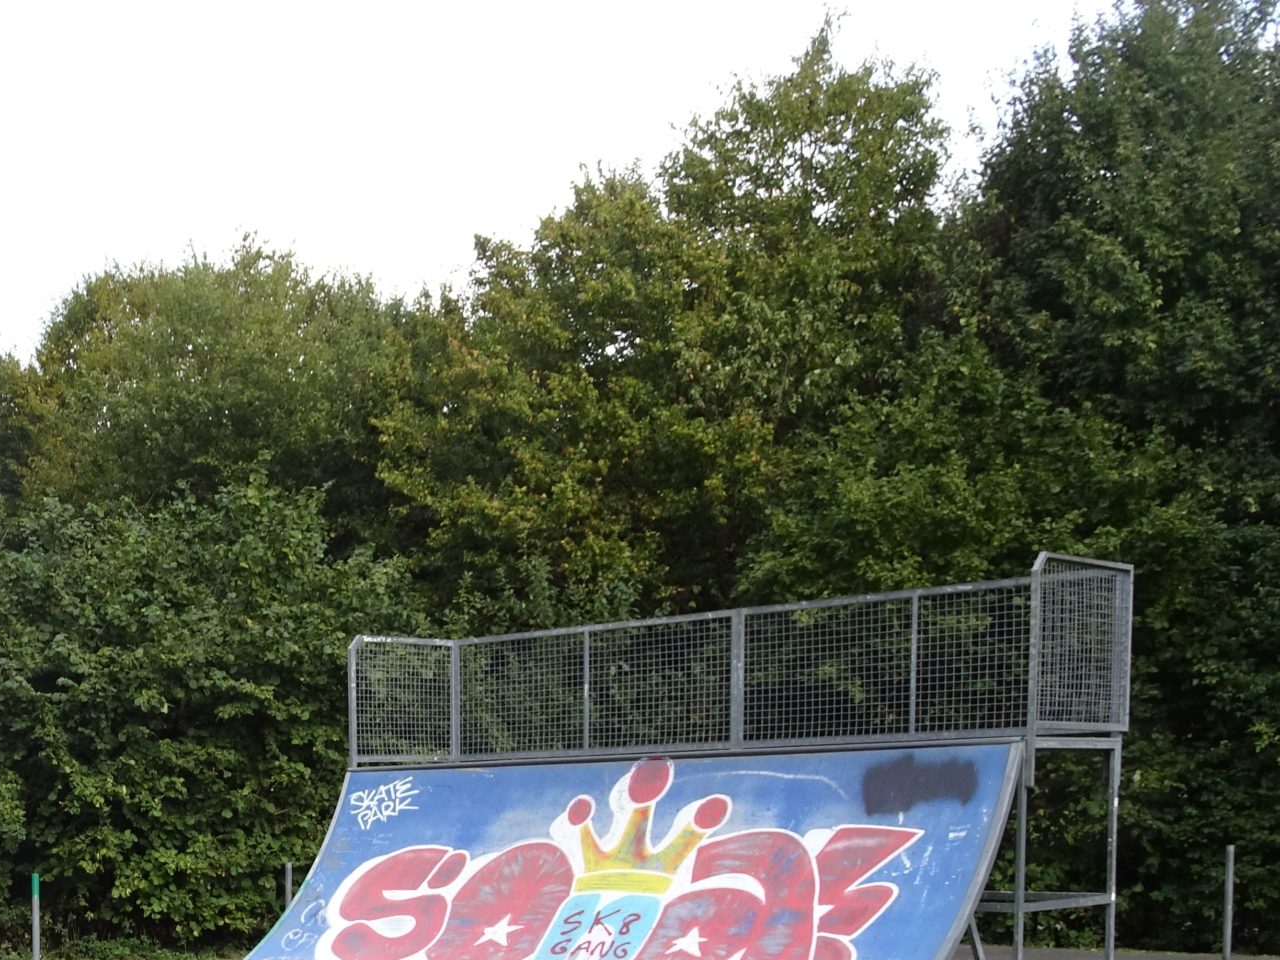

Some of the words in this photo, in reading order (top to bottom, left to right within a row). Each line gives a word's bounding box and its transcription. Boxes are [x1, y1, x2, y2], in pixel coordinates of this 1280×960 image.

[349, 776, 420, 814] SKATE
[357, 797, 420, 830] PARK
[560, 908, 642, 936] SK8
[550, 938, 632, 959] GANG
